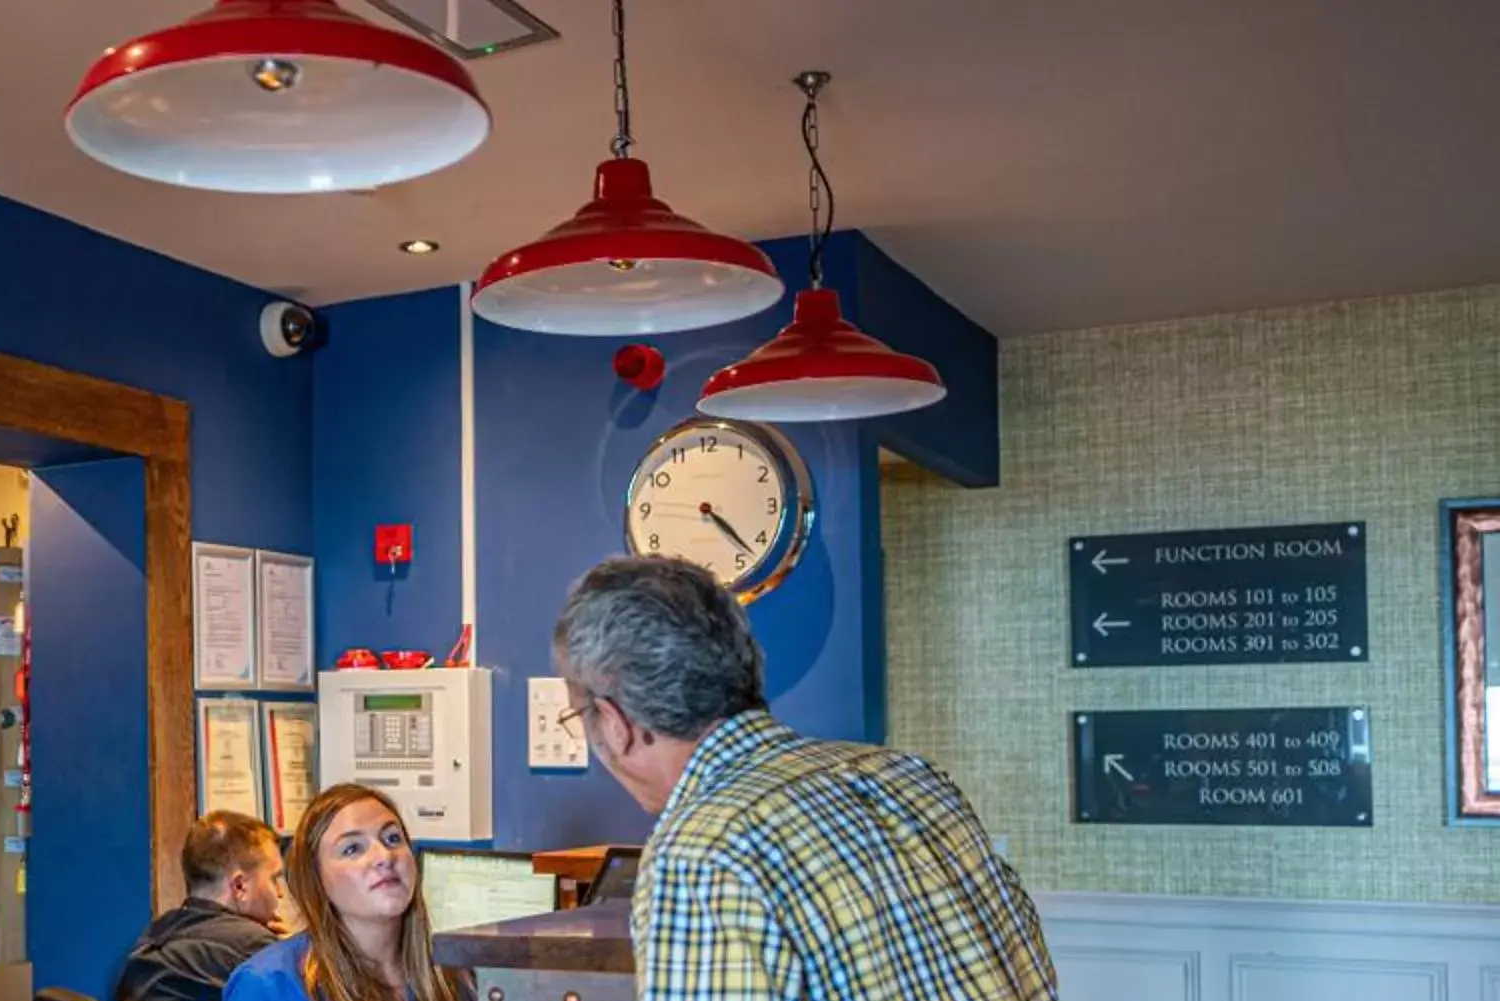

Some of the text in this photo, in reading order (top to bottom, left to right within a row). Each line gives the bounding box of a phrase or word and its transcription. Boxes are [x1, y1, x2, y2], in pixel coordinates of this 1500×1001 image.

[699, 436, 717, 453] 12
[737, 444, 743, 459] 1
[671, 447, 685, 463] 11
[649, 471, 671, 488] 10
[757, 466, 769, 482] 2
[639, 502, 651, 520] 9
[767, 498, 777, 515] 3
[649, 534, 660, 550] 8
[755, 530, 767, 545] 4
[1155, 540, 1343, 563] FUNCTION ROOM
[735, 553, 746, 569] 5
[1161, 586, 1337, 608] ROOMS 101 to 105
[1162, 610, 1338, 631] ROOMS 201 to 205
[1161, 633, 1339, 653] ROOMS 301 to 302
[1164, 731, 1340, 751] ROOMS 401 to 409
[1164, 759, 1341, 778] ROOMS 501 to 508
[1199, 788, 1303, 805] ROOM 601
